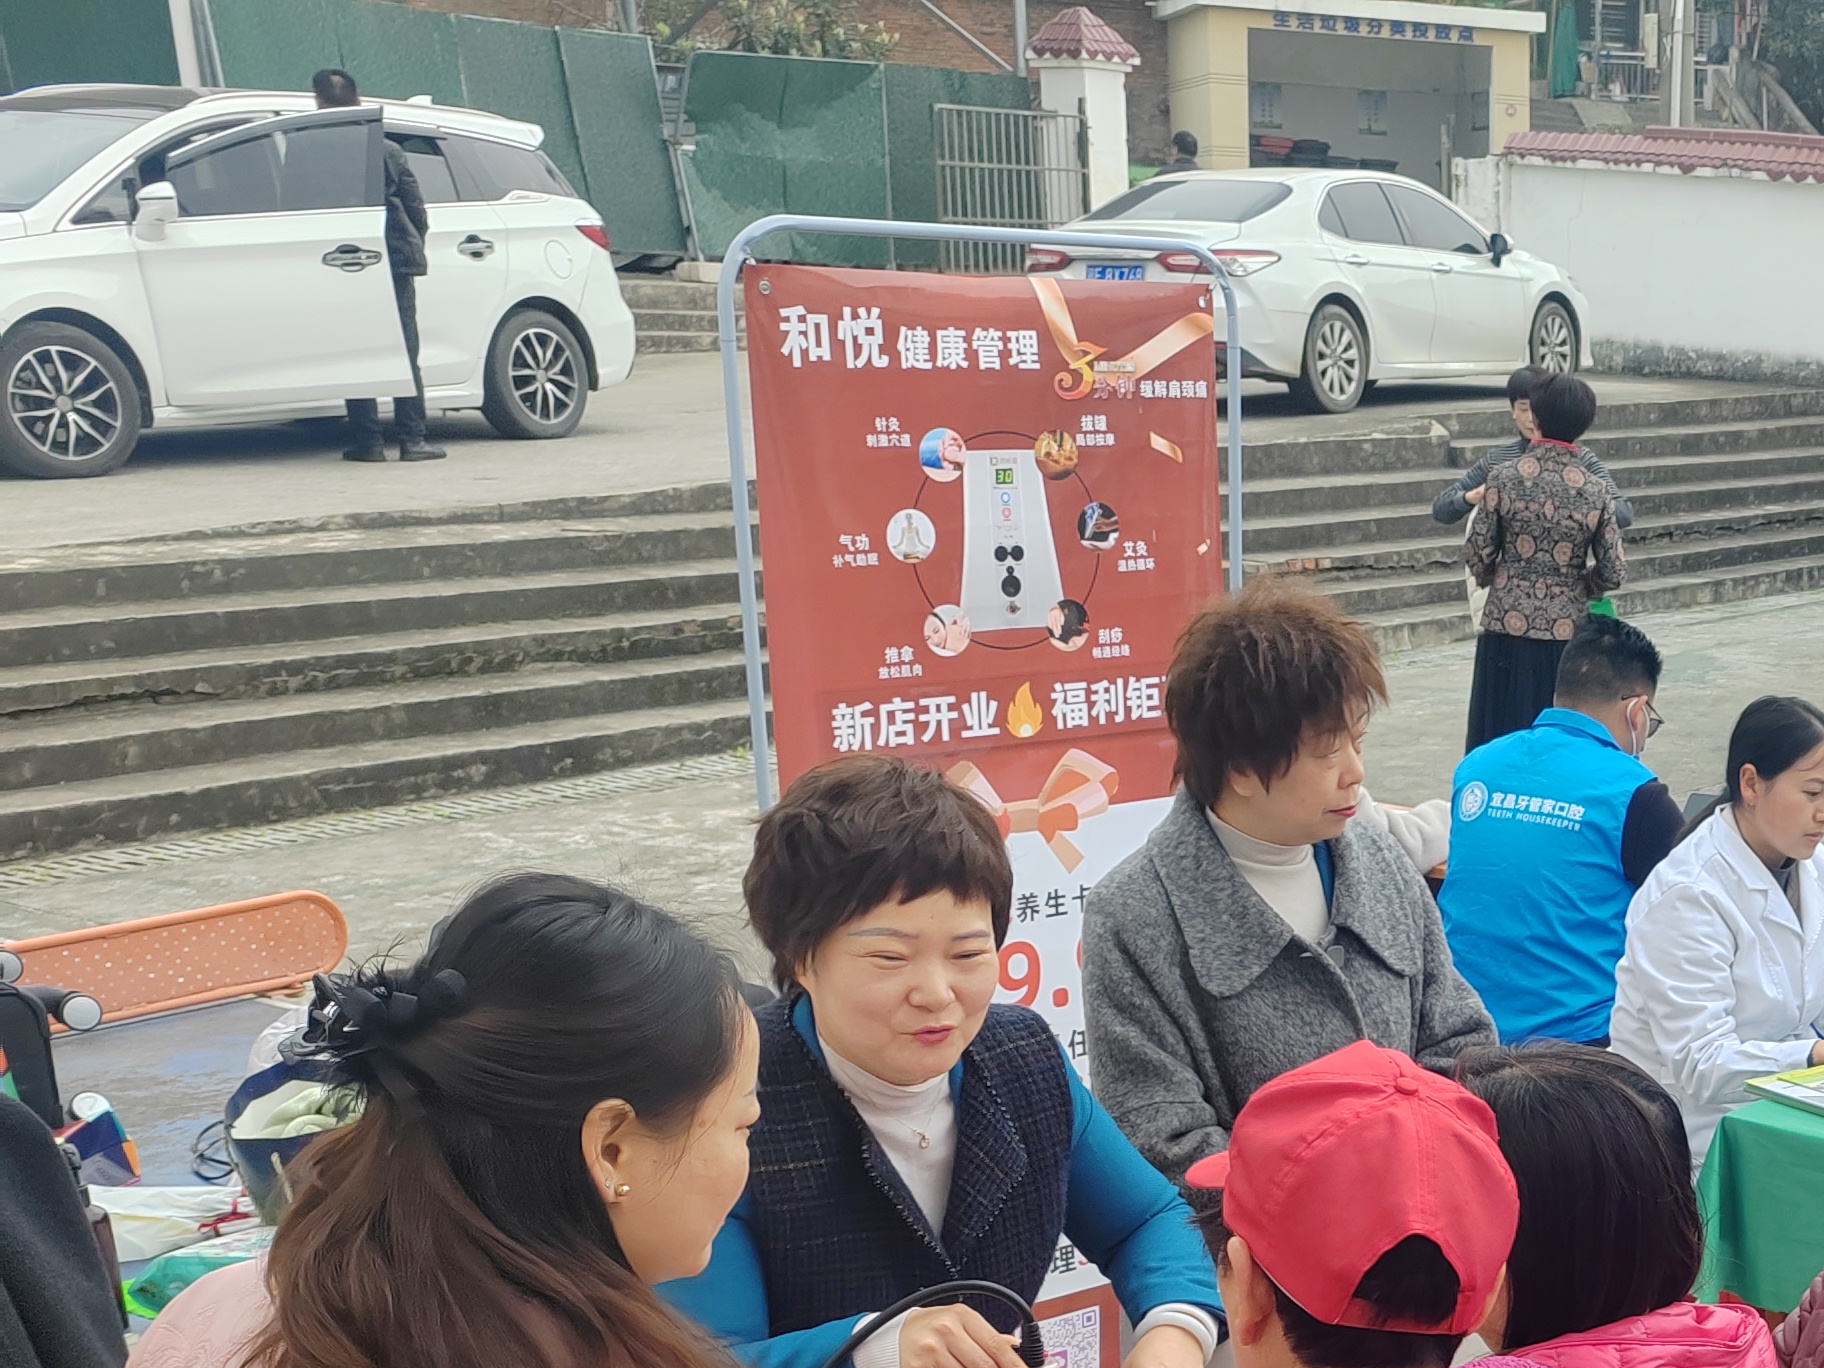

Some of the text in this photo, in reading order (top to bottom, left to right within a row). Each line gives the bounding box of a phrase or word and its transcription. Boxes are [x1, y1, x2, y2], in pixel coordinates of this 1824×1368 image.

[1273, 11, 1474, 43] 生活垃圾分类投放点
[779, 305, 1041, 369] 和悦 健康管理
[875, 417, 900, 432] 针灸
[1080, 414, 1107, 431] 拔罐
[839, 533, 870, 551] 气功
[1123, 540, 1148, 557] 艾灸
[832, 553, 879, 568] 补气助眠
[1098, 627, 1122, 644] 刮痧
[884, 645, 914, 664] 推拿
[878, 664, 922, 679] 放松肌肉
[831, 676, 1166, 752] 新店开业 福利钜
[1489, 791, 1585, 821] 宜昌牙管家口腔
[1487, 809, 1513, 819] TEETH
[1516, 812, 1581, 832] HOUSEKEEPER
